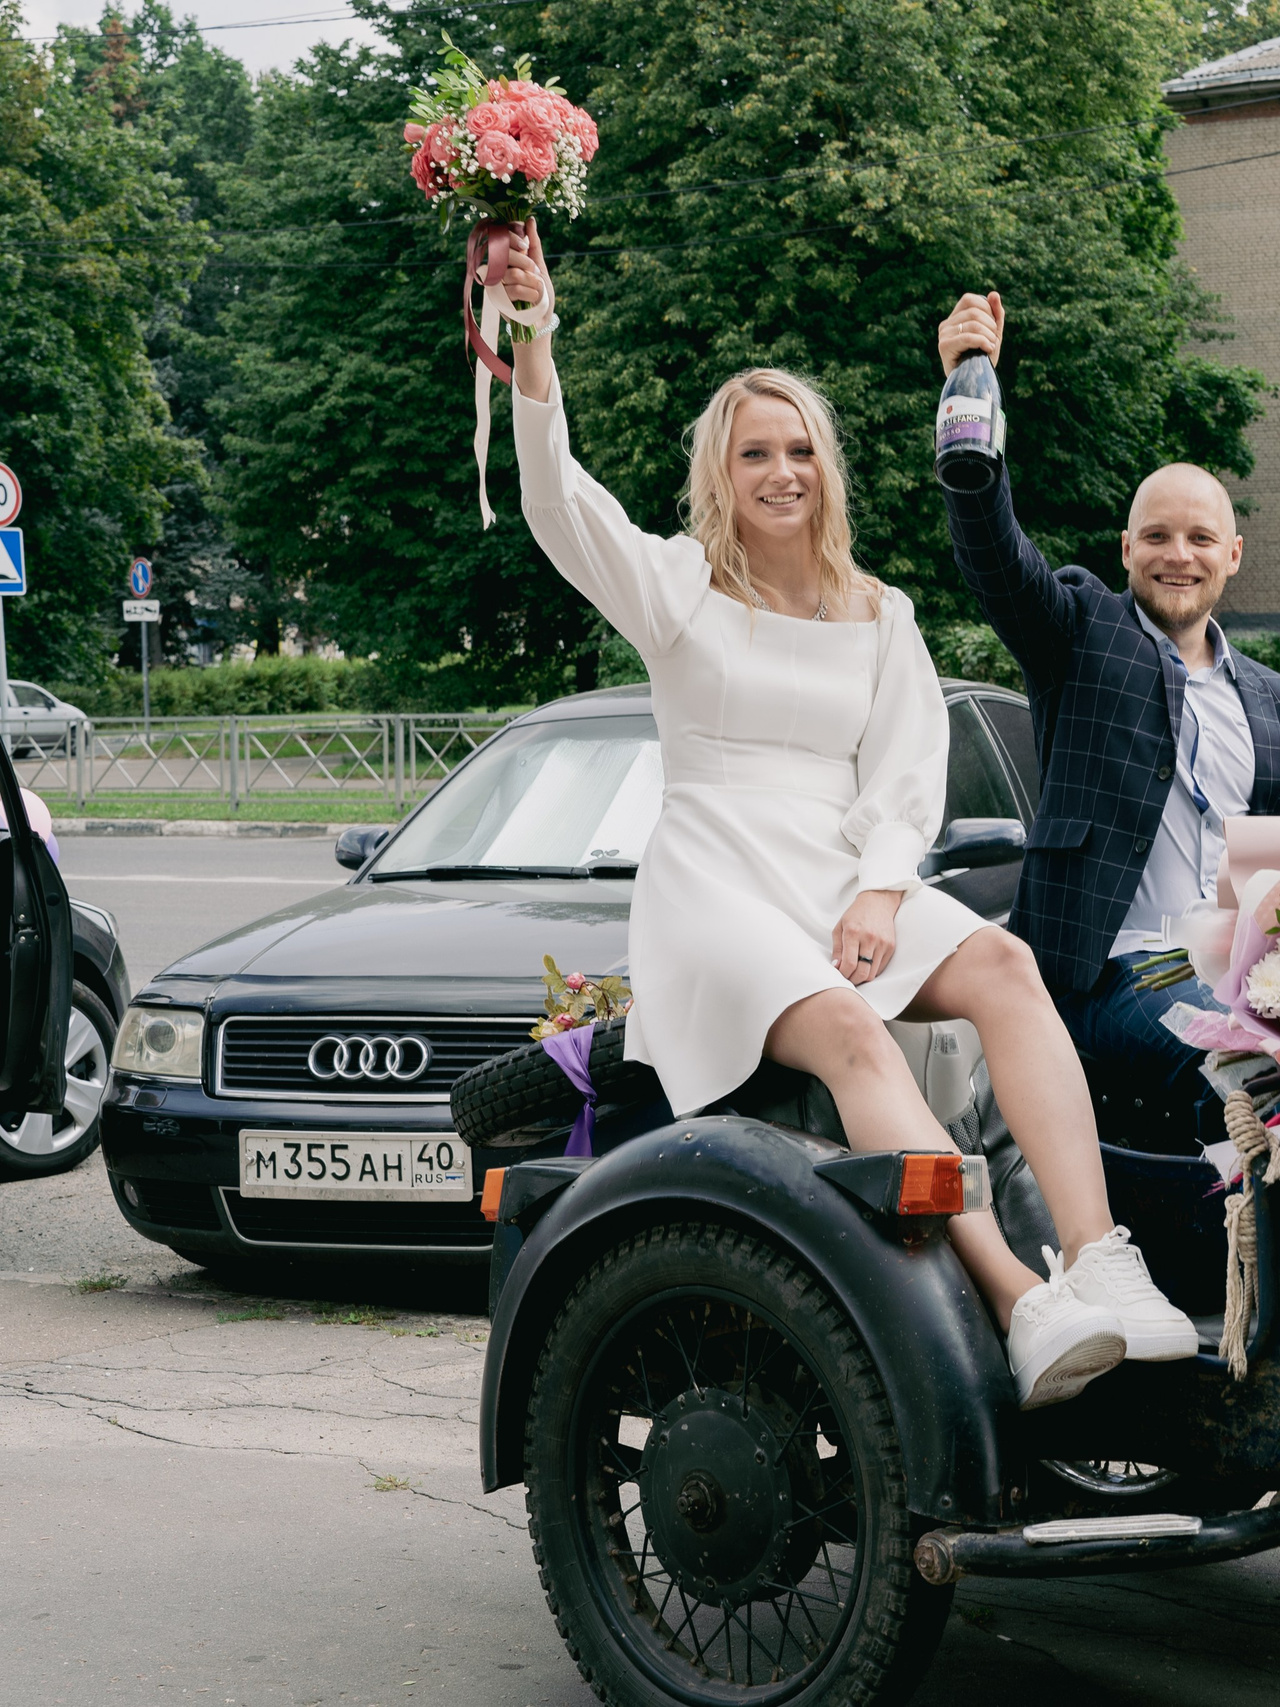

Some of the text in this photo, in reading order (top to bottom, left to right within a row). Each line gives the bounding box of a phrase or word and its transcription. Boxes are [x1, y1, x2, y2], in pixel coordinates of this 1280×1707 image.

[945, 415, 980, 426] STEFANO
[0, 483, 7, 506] 0
[417, 1142, 454, 1171] 40
[415, 1173, 444, 1184] RUS
